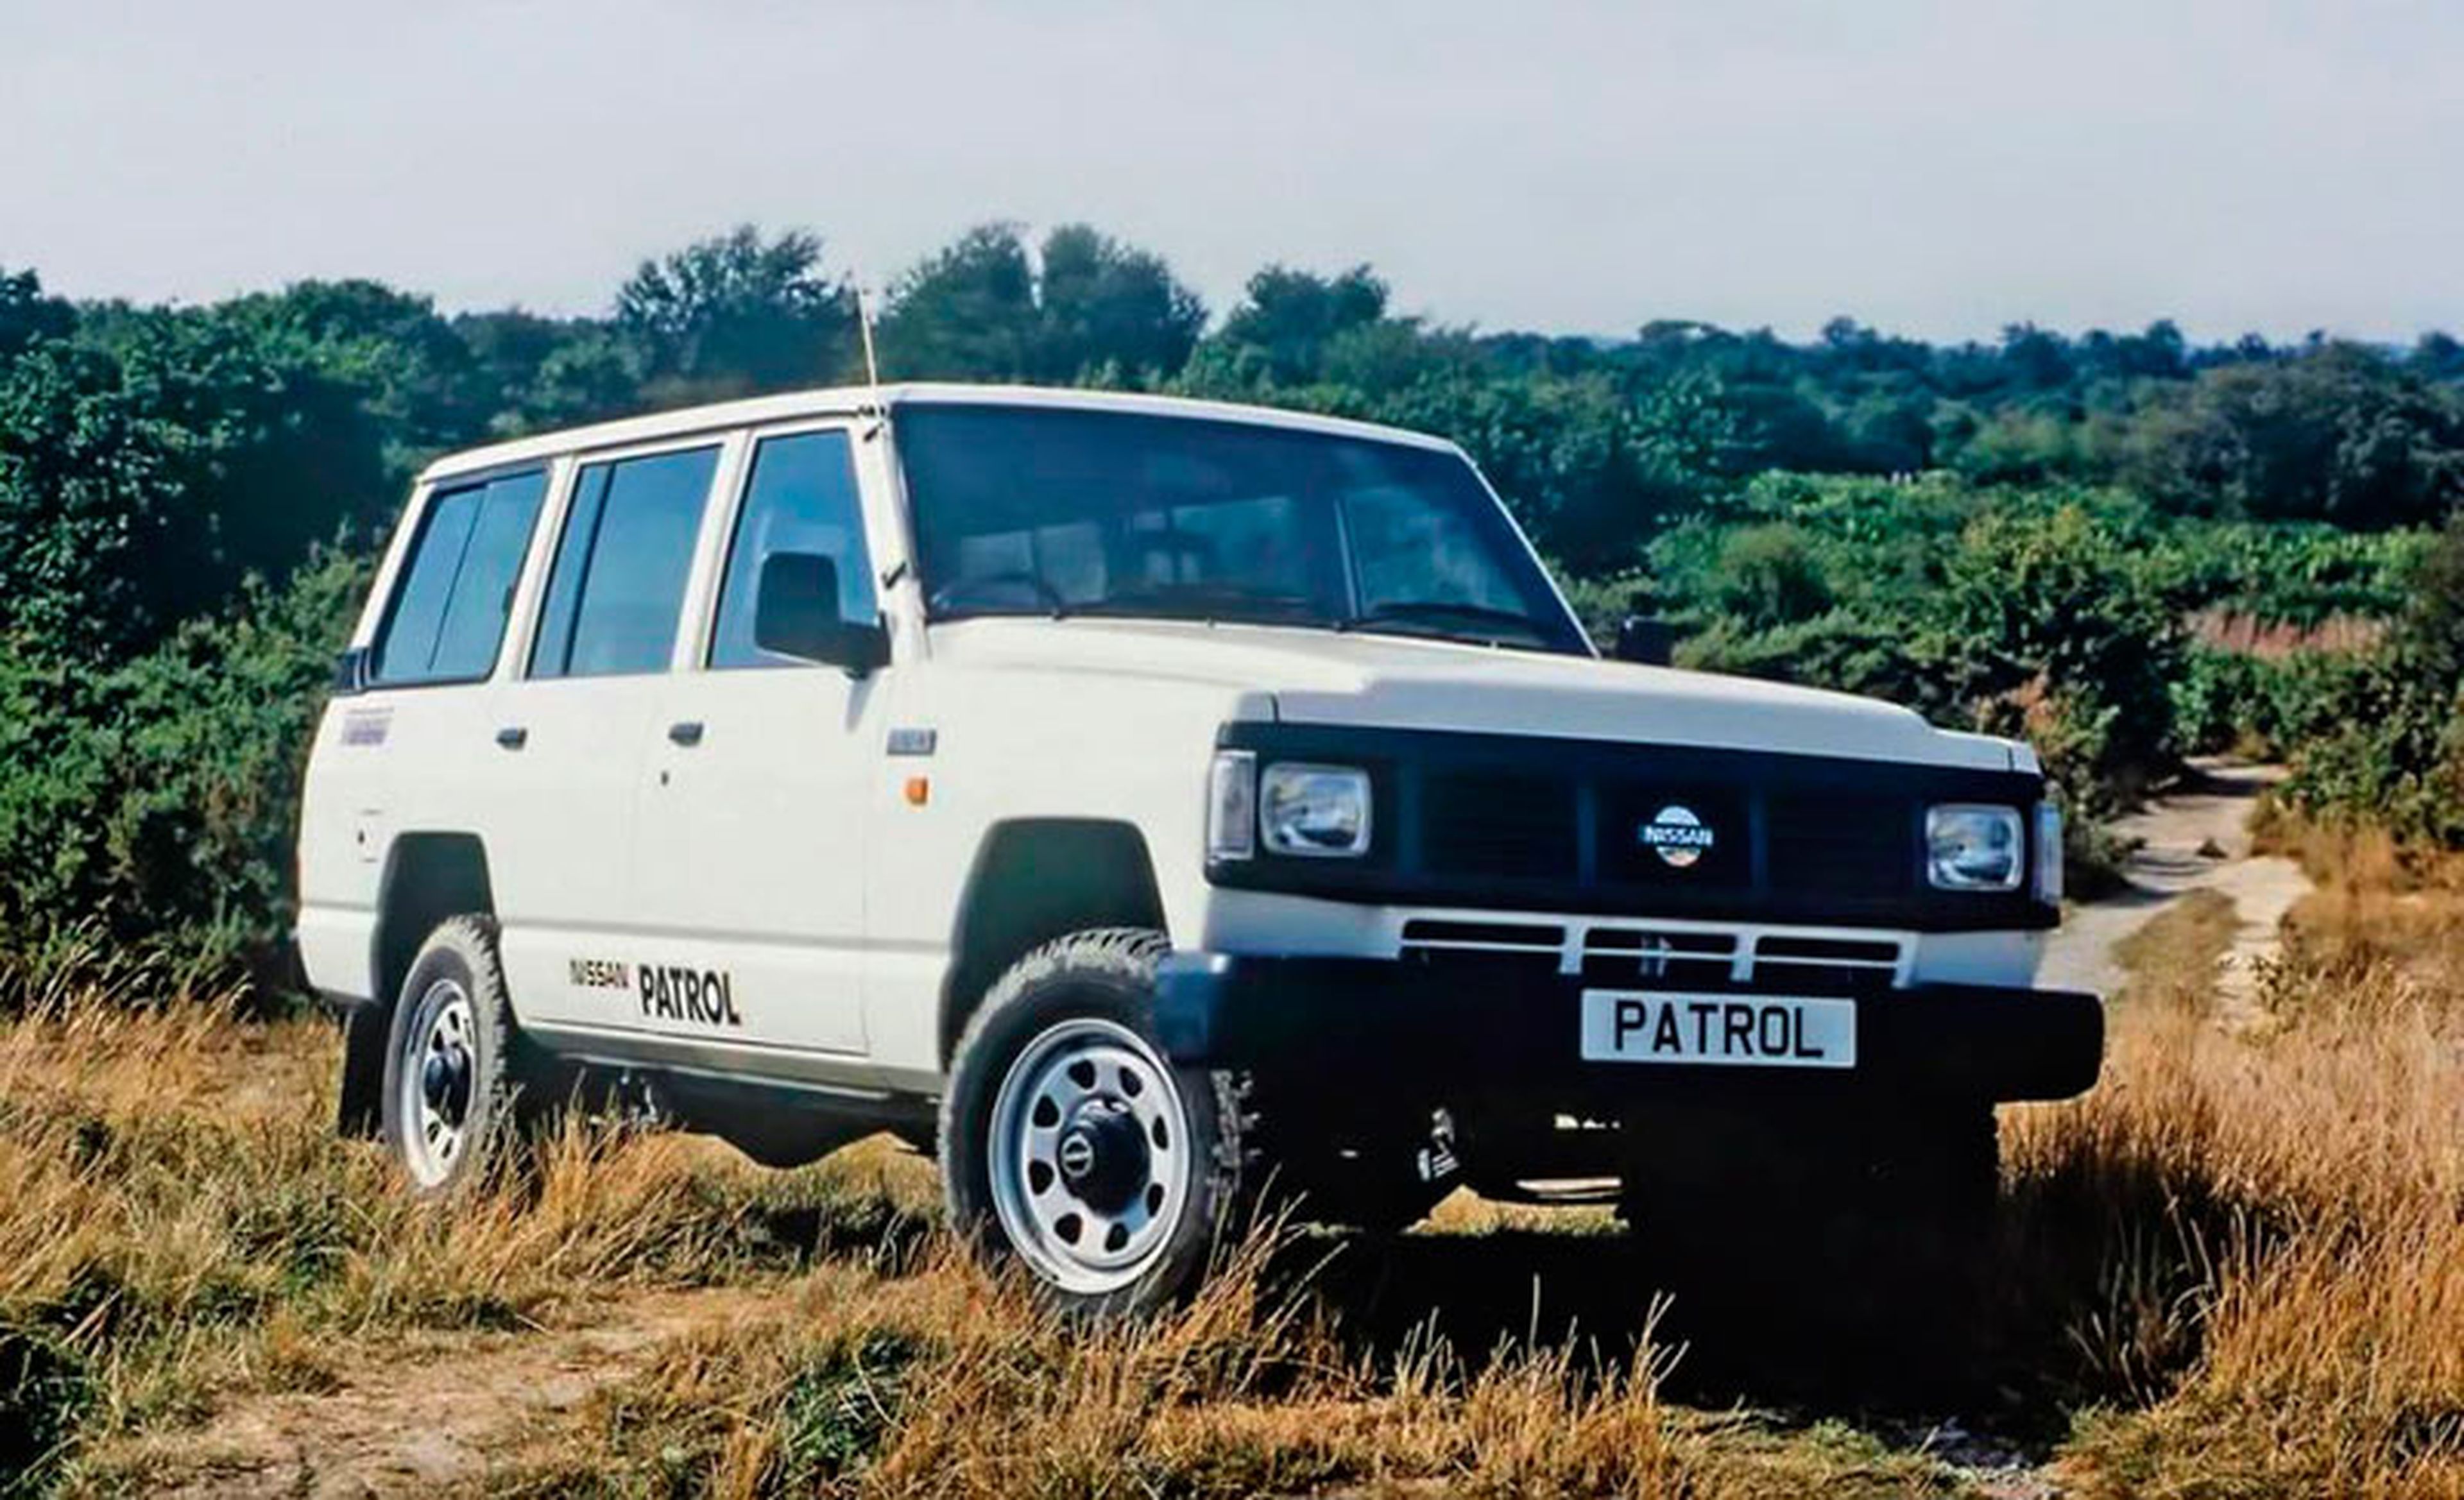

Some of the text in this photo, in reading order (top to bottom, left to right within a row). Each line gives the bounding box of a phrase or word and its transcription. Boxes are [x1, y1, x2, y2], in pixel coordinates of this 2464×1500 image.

[1643, 825, 1714, 847] NISSAN
[569, 959, 740, 1025] NISSAN PATROL
[1614, 1000, 1824, 1057] PATROL
